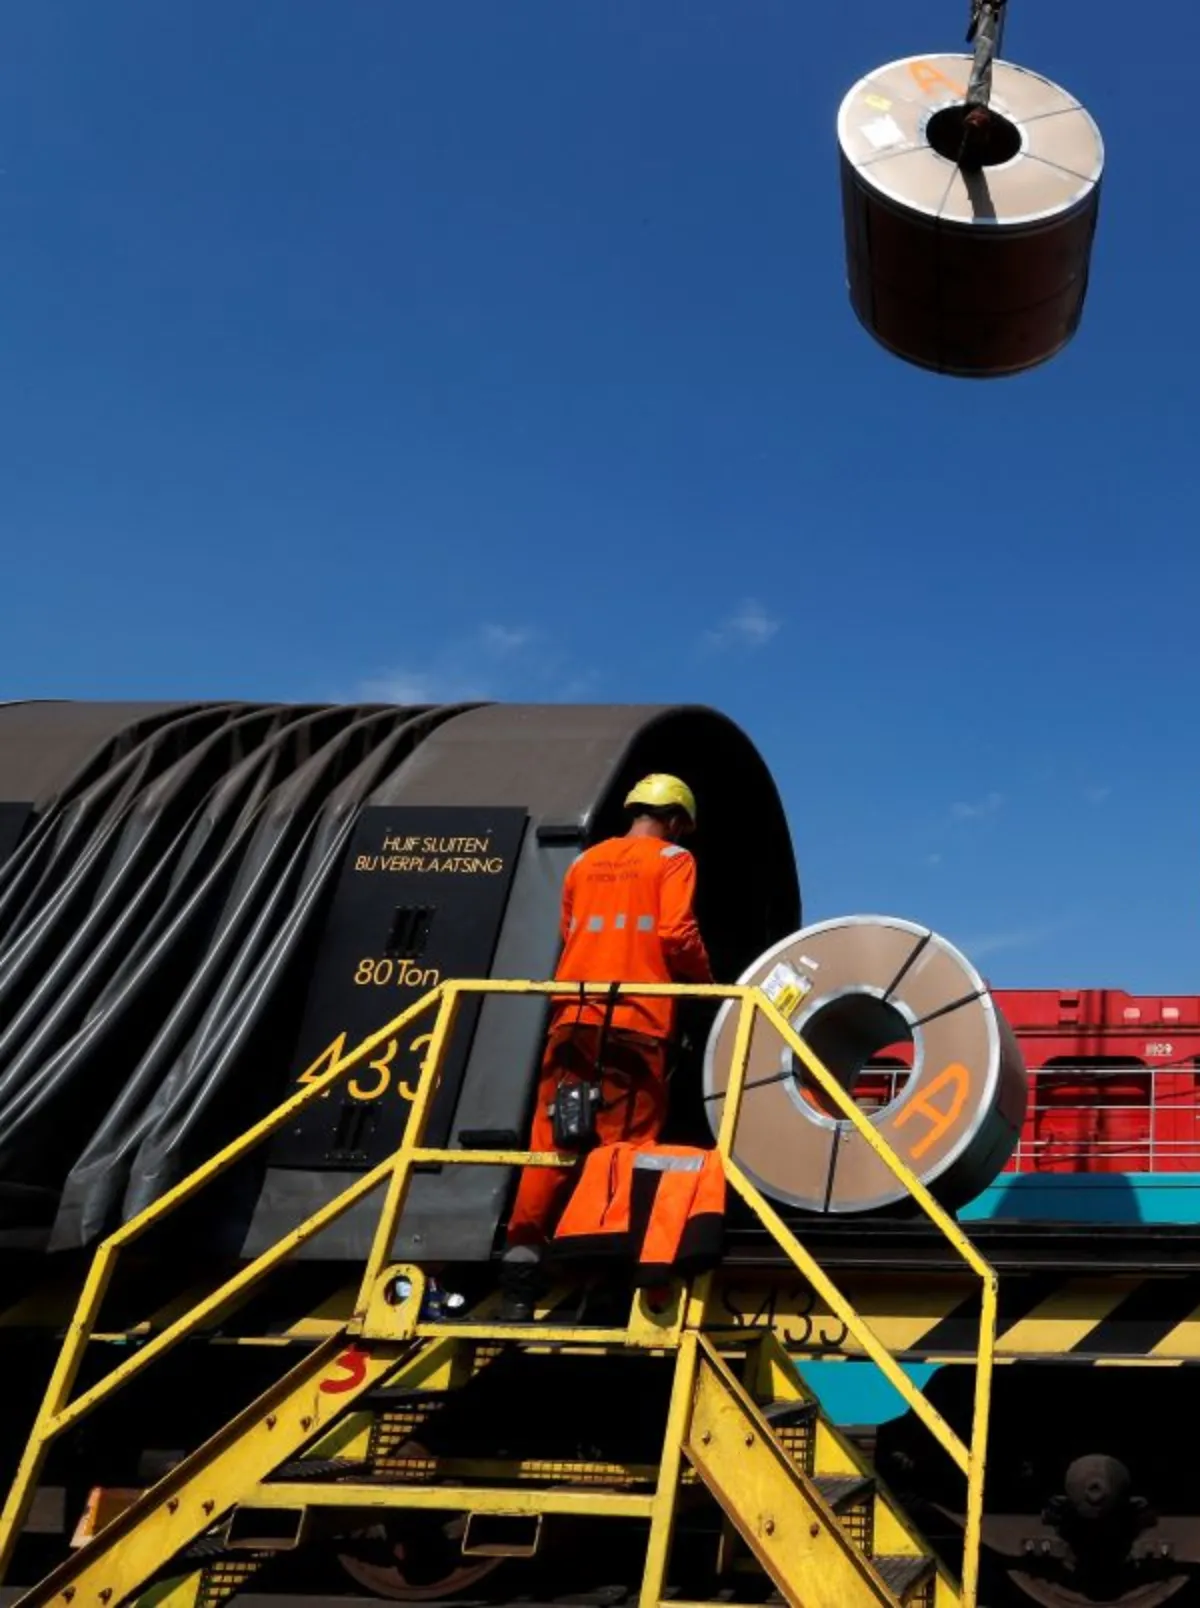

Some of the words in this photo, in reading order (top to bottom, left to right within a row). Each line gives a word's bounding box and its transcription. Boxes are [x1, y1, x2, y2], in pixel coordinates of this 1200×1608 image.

[382, 835, 420, 851] HUIF
[421, 837, 490, 853] SLUITEN
[379, 856, 504, 874] VERPLAATSING
[353, 957, 395, 986] 80
[396, 958, 440, 987] Ton
[892, 1062, 970, 1161] A
